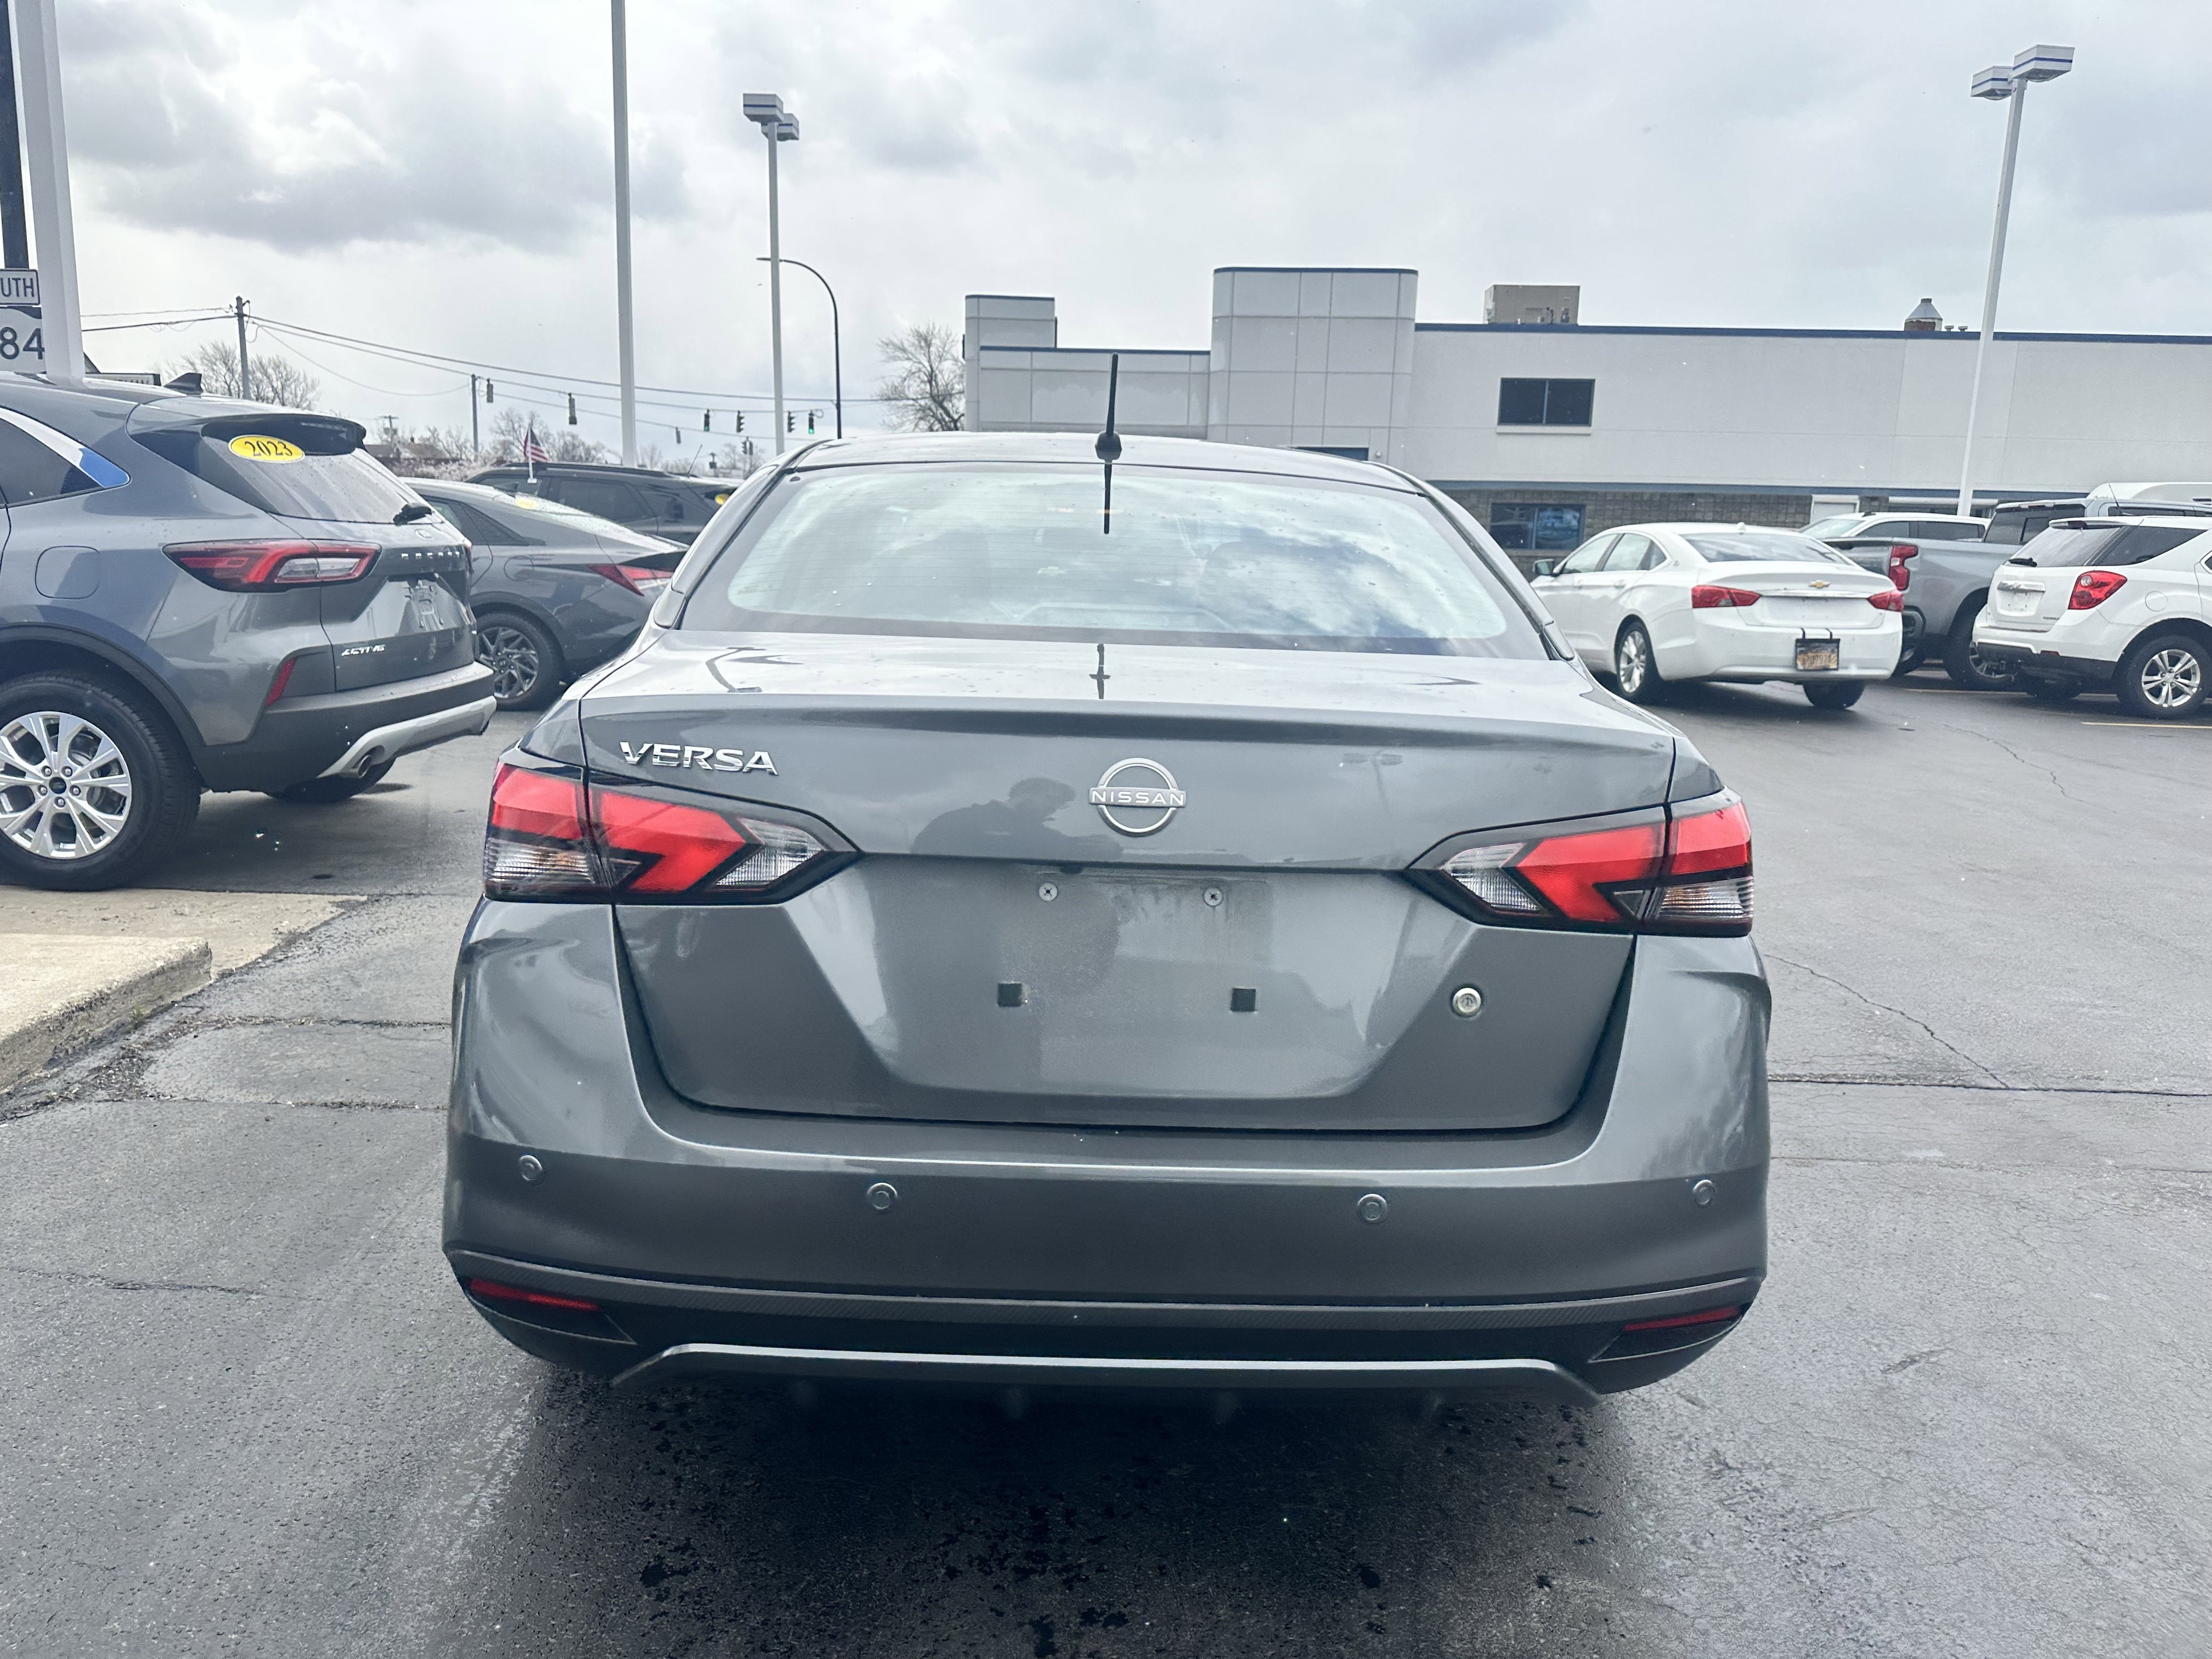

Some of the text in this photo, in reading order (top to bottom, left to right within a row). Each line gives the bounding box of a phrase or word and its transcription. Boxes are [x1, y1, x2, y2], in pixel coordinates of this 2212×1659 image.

[0, 326, 45, 360] 84
[244, 441, 292, 456] 2023
[620, 741, 778, 775] VERSA
[1091, 791, 1184, 805] NISSAN
